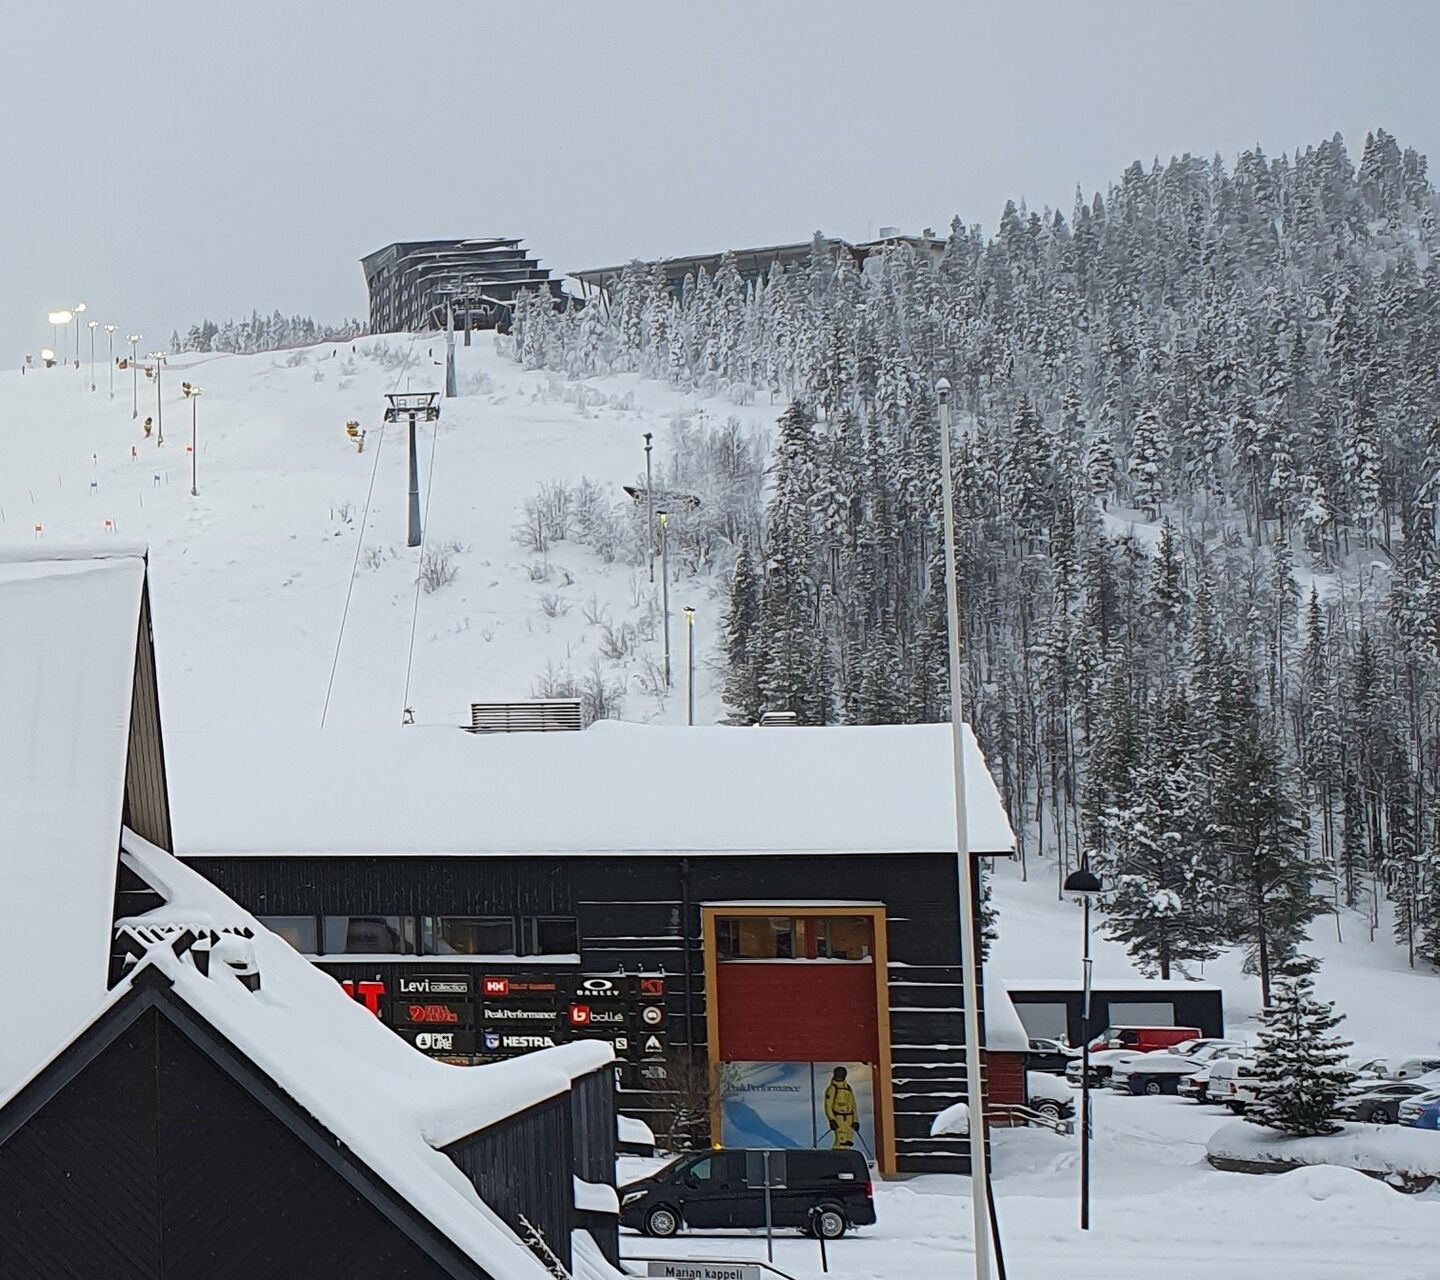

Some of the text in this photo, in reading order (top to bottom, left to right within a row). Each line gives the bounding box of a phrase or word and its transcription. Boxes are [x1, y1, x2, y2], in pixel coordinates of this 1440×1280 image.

[400, 978, 430, 993] Levi
[502, 1036, 555, 1047] HESTRA
[665, 1266, 743, 1280] Marian kappeli
